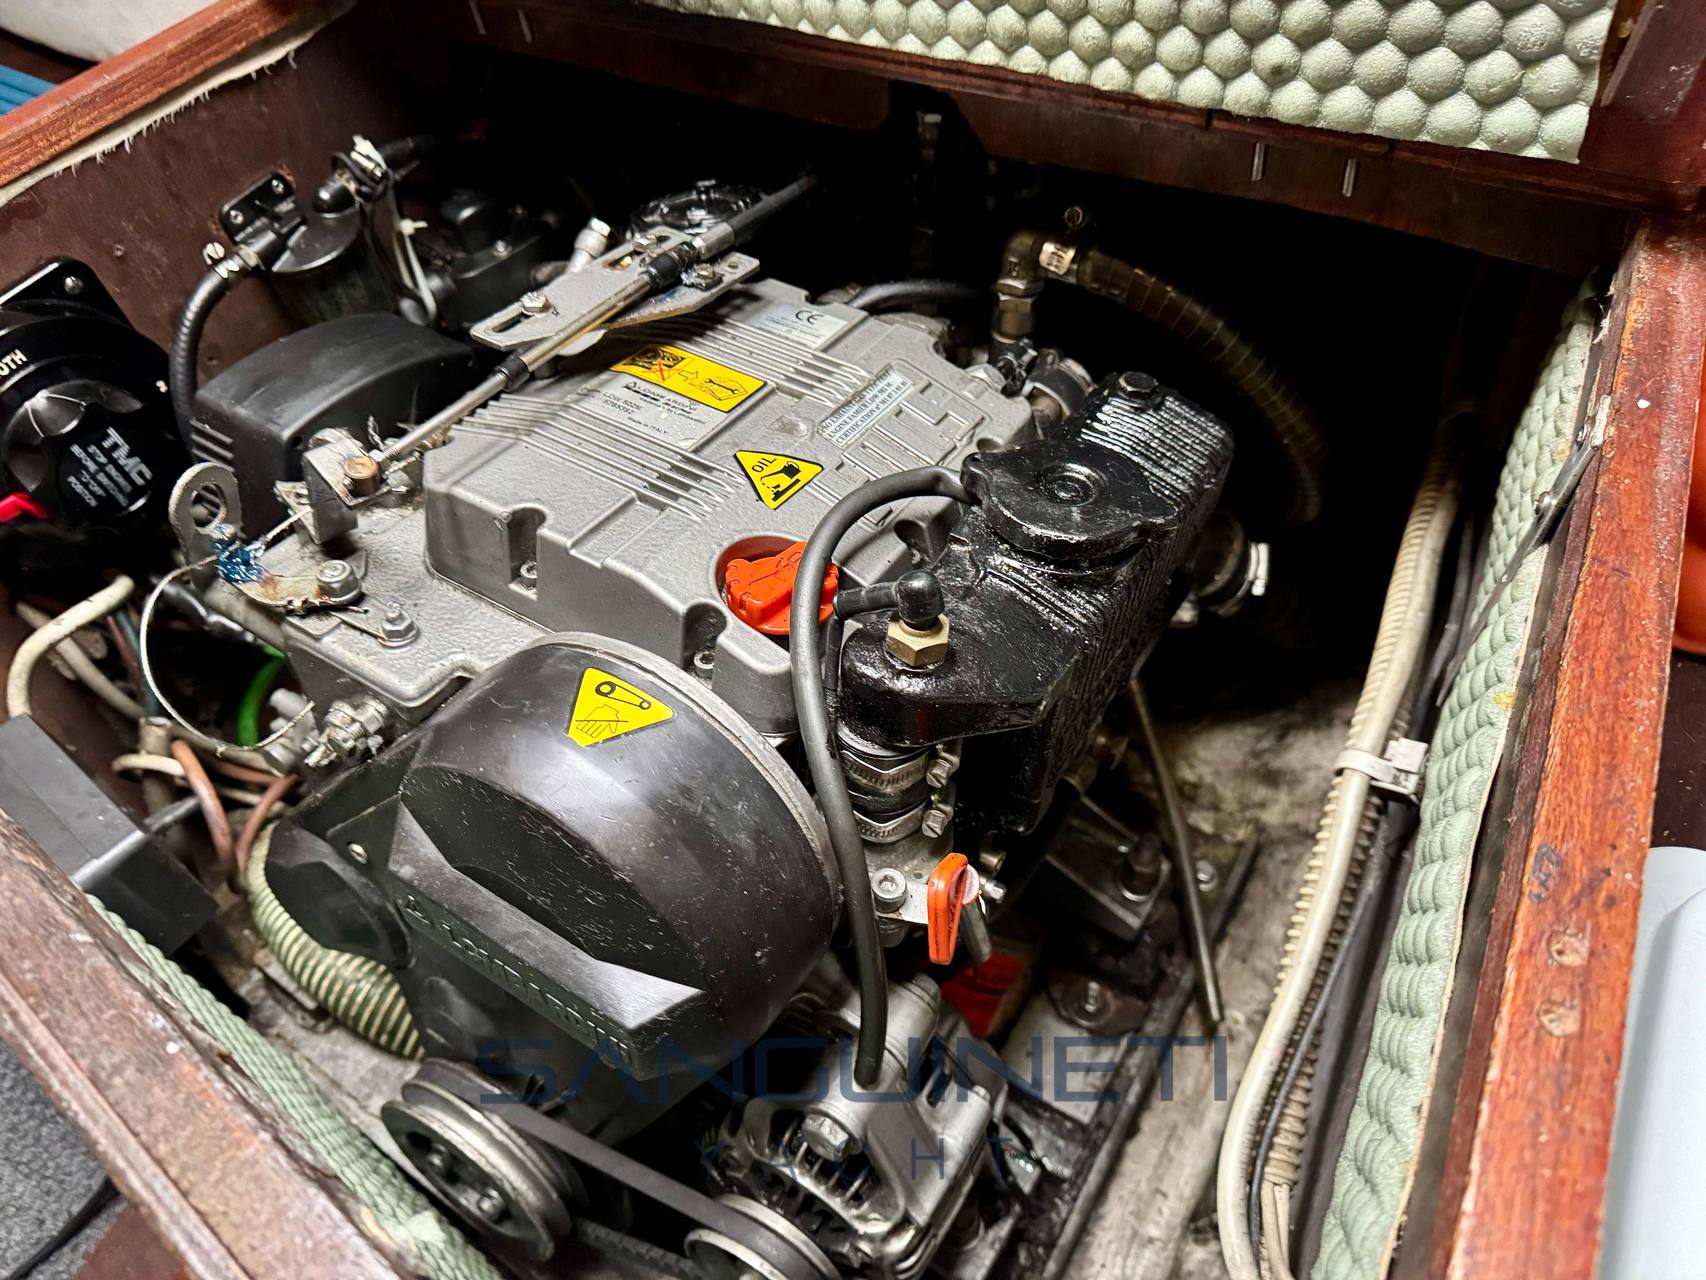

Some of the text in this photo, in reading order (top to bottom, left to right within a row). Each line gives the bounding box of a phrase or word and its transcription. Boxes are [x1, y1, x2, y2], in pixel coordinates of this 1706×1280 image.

[0, 349, 27, 376] OTH
[846, 400, 870, 421] FAMILY
[648, 423, 668, 435] ITALY
[836, 409, 877, 443] CERTIFICATION
[70, 444, 98, 473] BEFORE
[87, 444, 108, 465] STOP
[101, 427, 153, 486] TMC
[752, 458, 776, 472] OIL
[67, 475, 97, 507] POSITION
